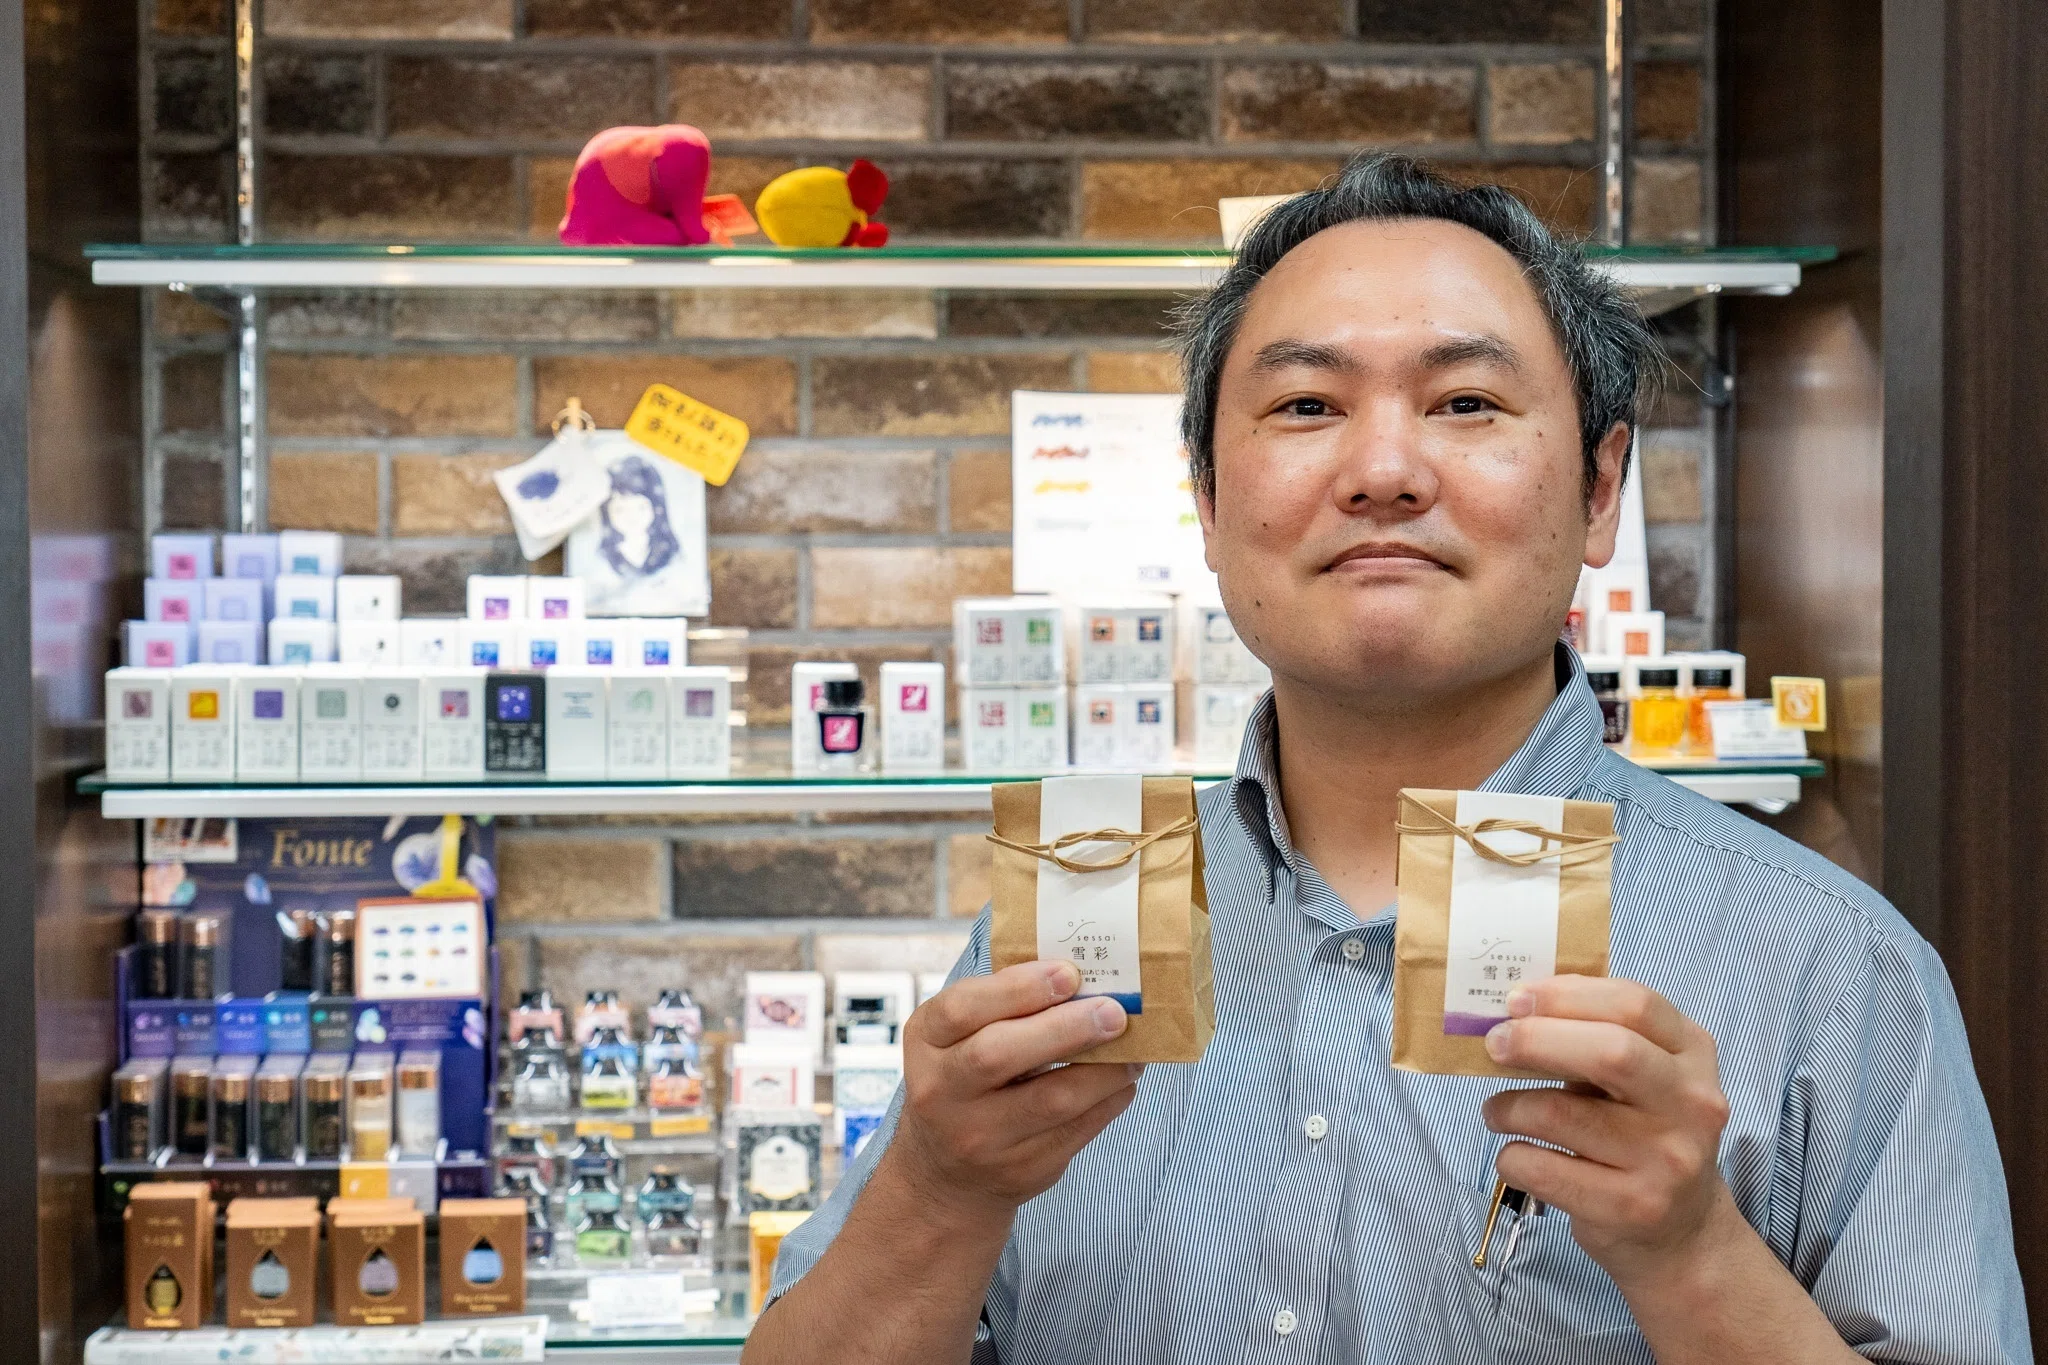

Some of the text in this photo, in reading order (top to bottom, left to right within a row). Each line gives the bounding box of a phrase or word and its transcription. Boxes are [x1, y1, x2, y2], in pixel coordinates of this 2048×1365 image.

[270, 828, 374, 869] Fonte
[1076, 934, 1116, 942] sessai
[1490, 953, 1532, 963] sessai
